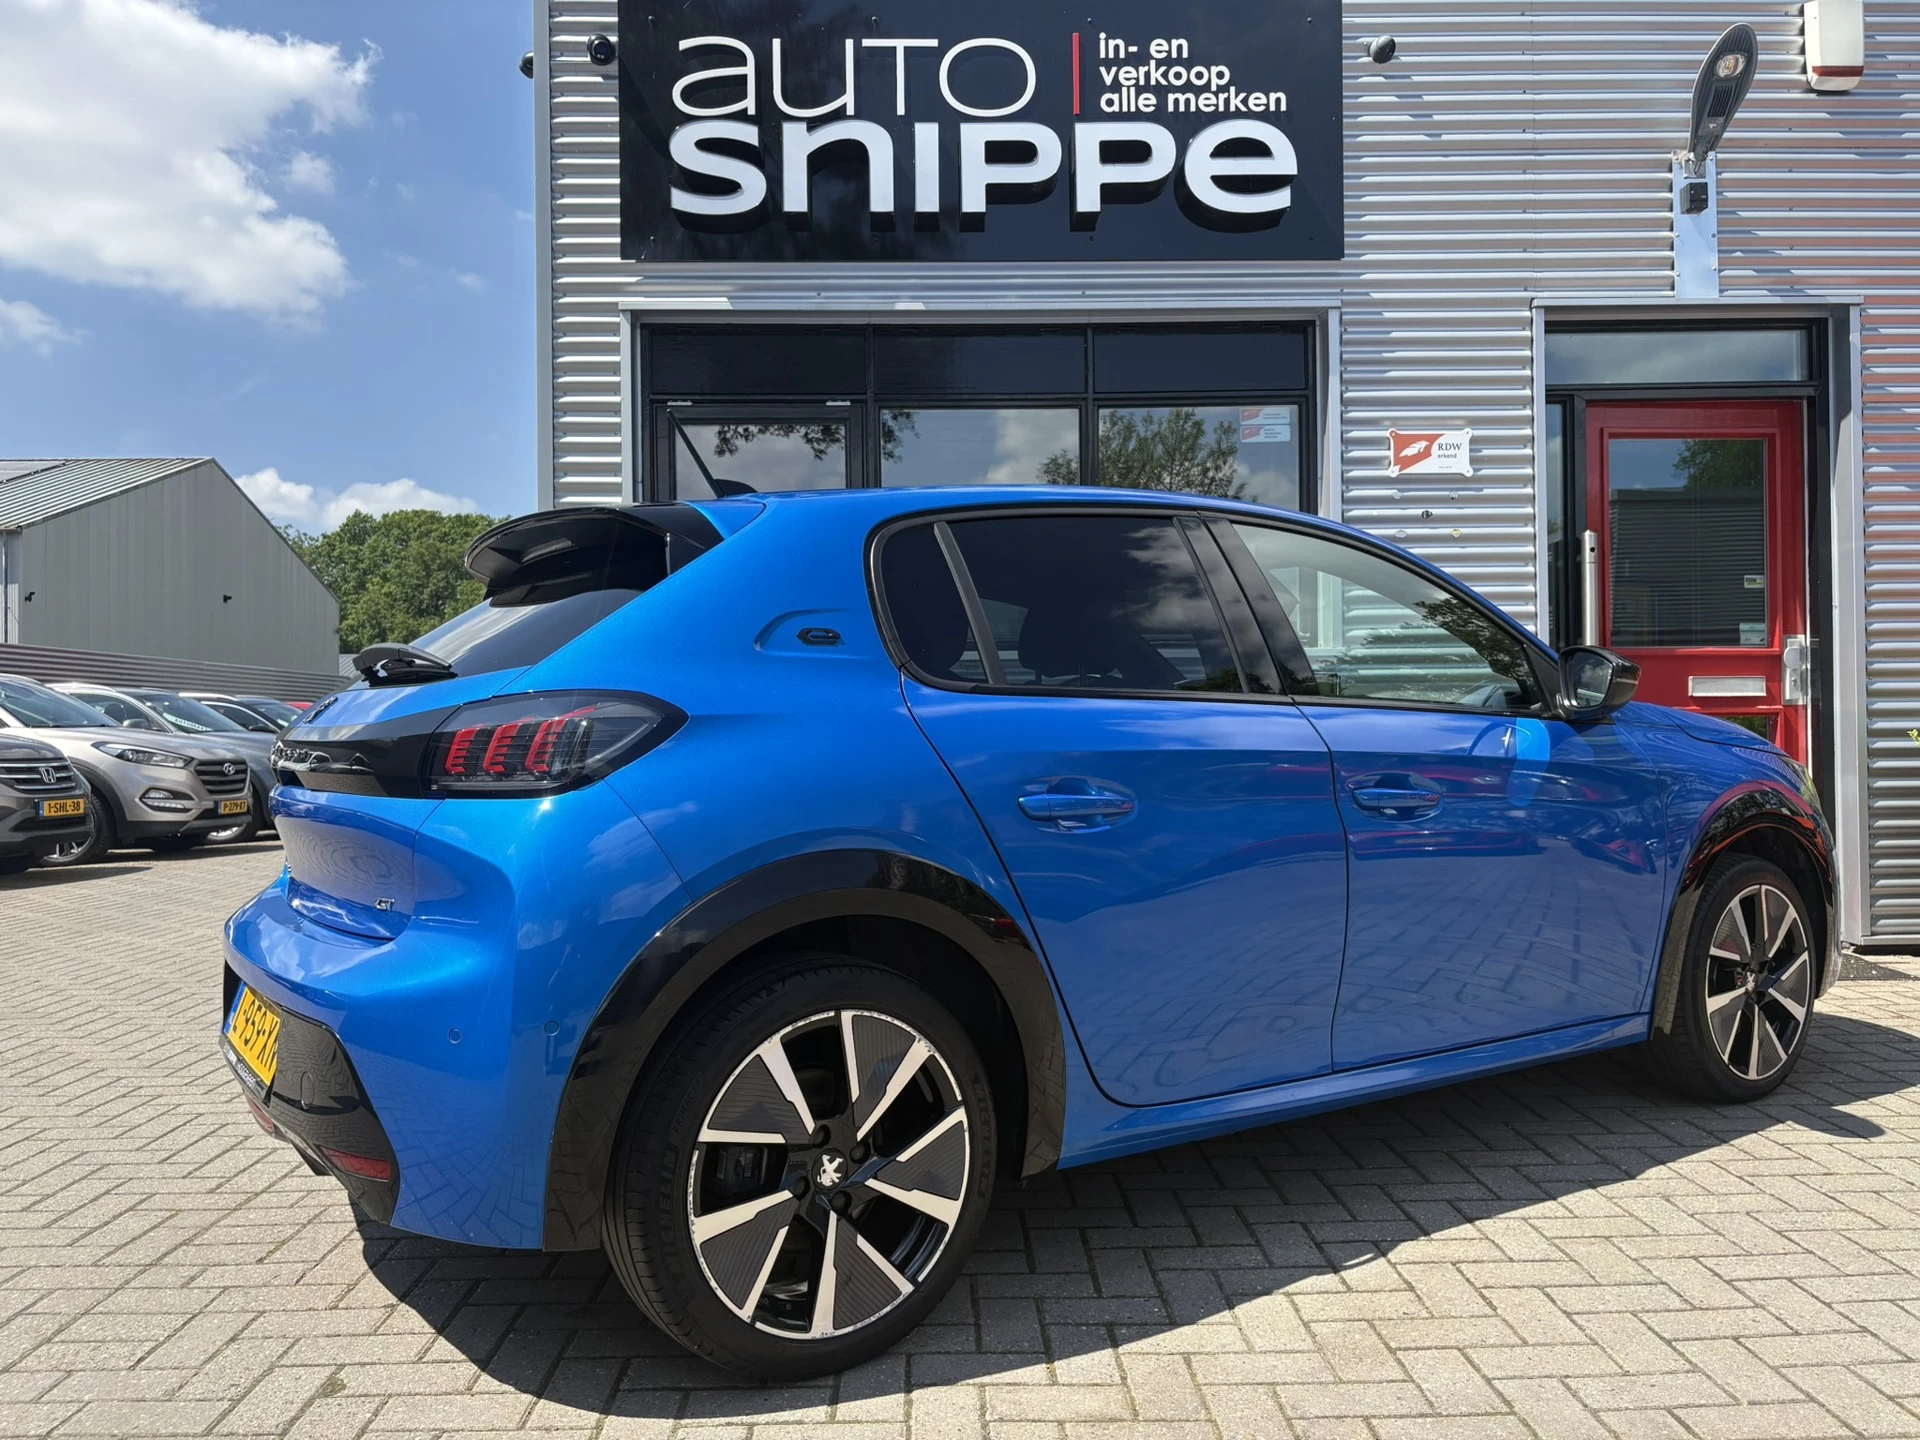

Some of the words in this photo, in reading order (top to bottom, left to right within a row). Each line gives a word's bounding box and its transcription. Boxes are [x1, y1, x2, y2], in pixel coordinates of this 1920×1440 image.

[1099, 31, 1138, 59] in-
[1149, 38, 1189, 59] en
[1099, 59, 1231, 92] verkoop
[1099, 86, 1158, 113] alle
[1167, 86, 1287, 113] merken
[1437, 442, 1463, 452] RDW
[48, 800, 81, 814] 1-SHL-38
[374, 896, 395, 912] GT
